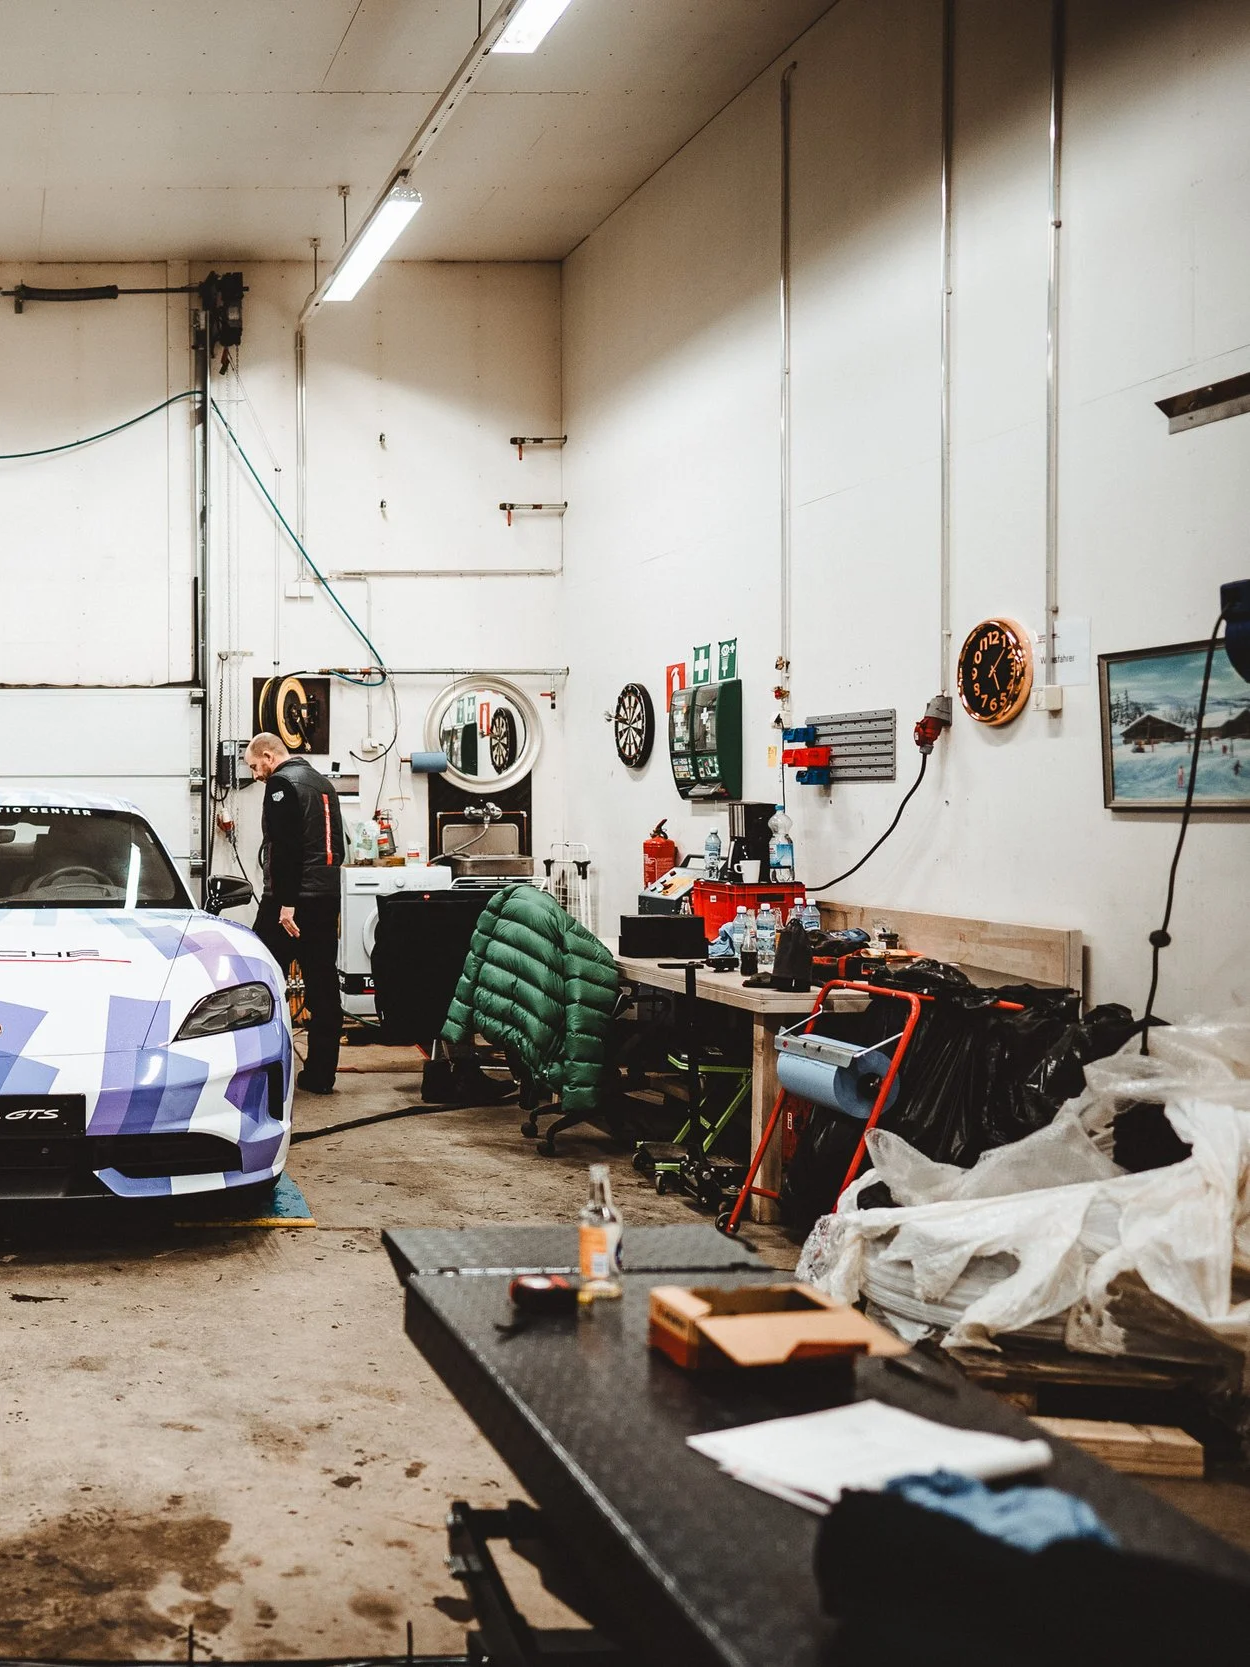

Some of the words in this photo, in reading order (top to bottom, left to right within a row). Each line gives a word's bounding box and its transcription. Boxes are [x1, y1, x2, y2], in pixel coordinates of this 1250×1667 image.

[987, 631, 999, 645] 12
[29, 807, 92, 816] CENTER
[5, 1109, 60, 1120] GTS
